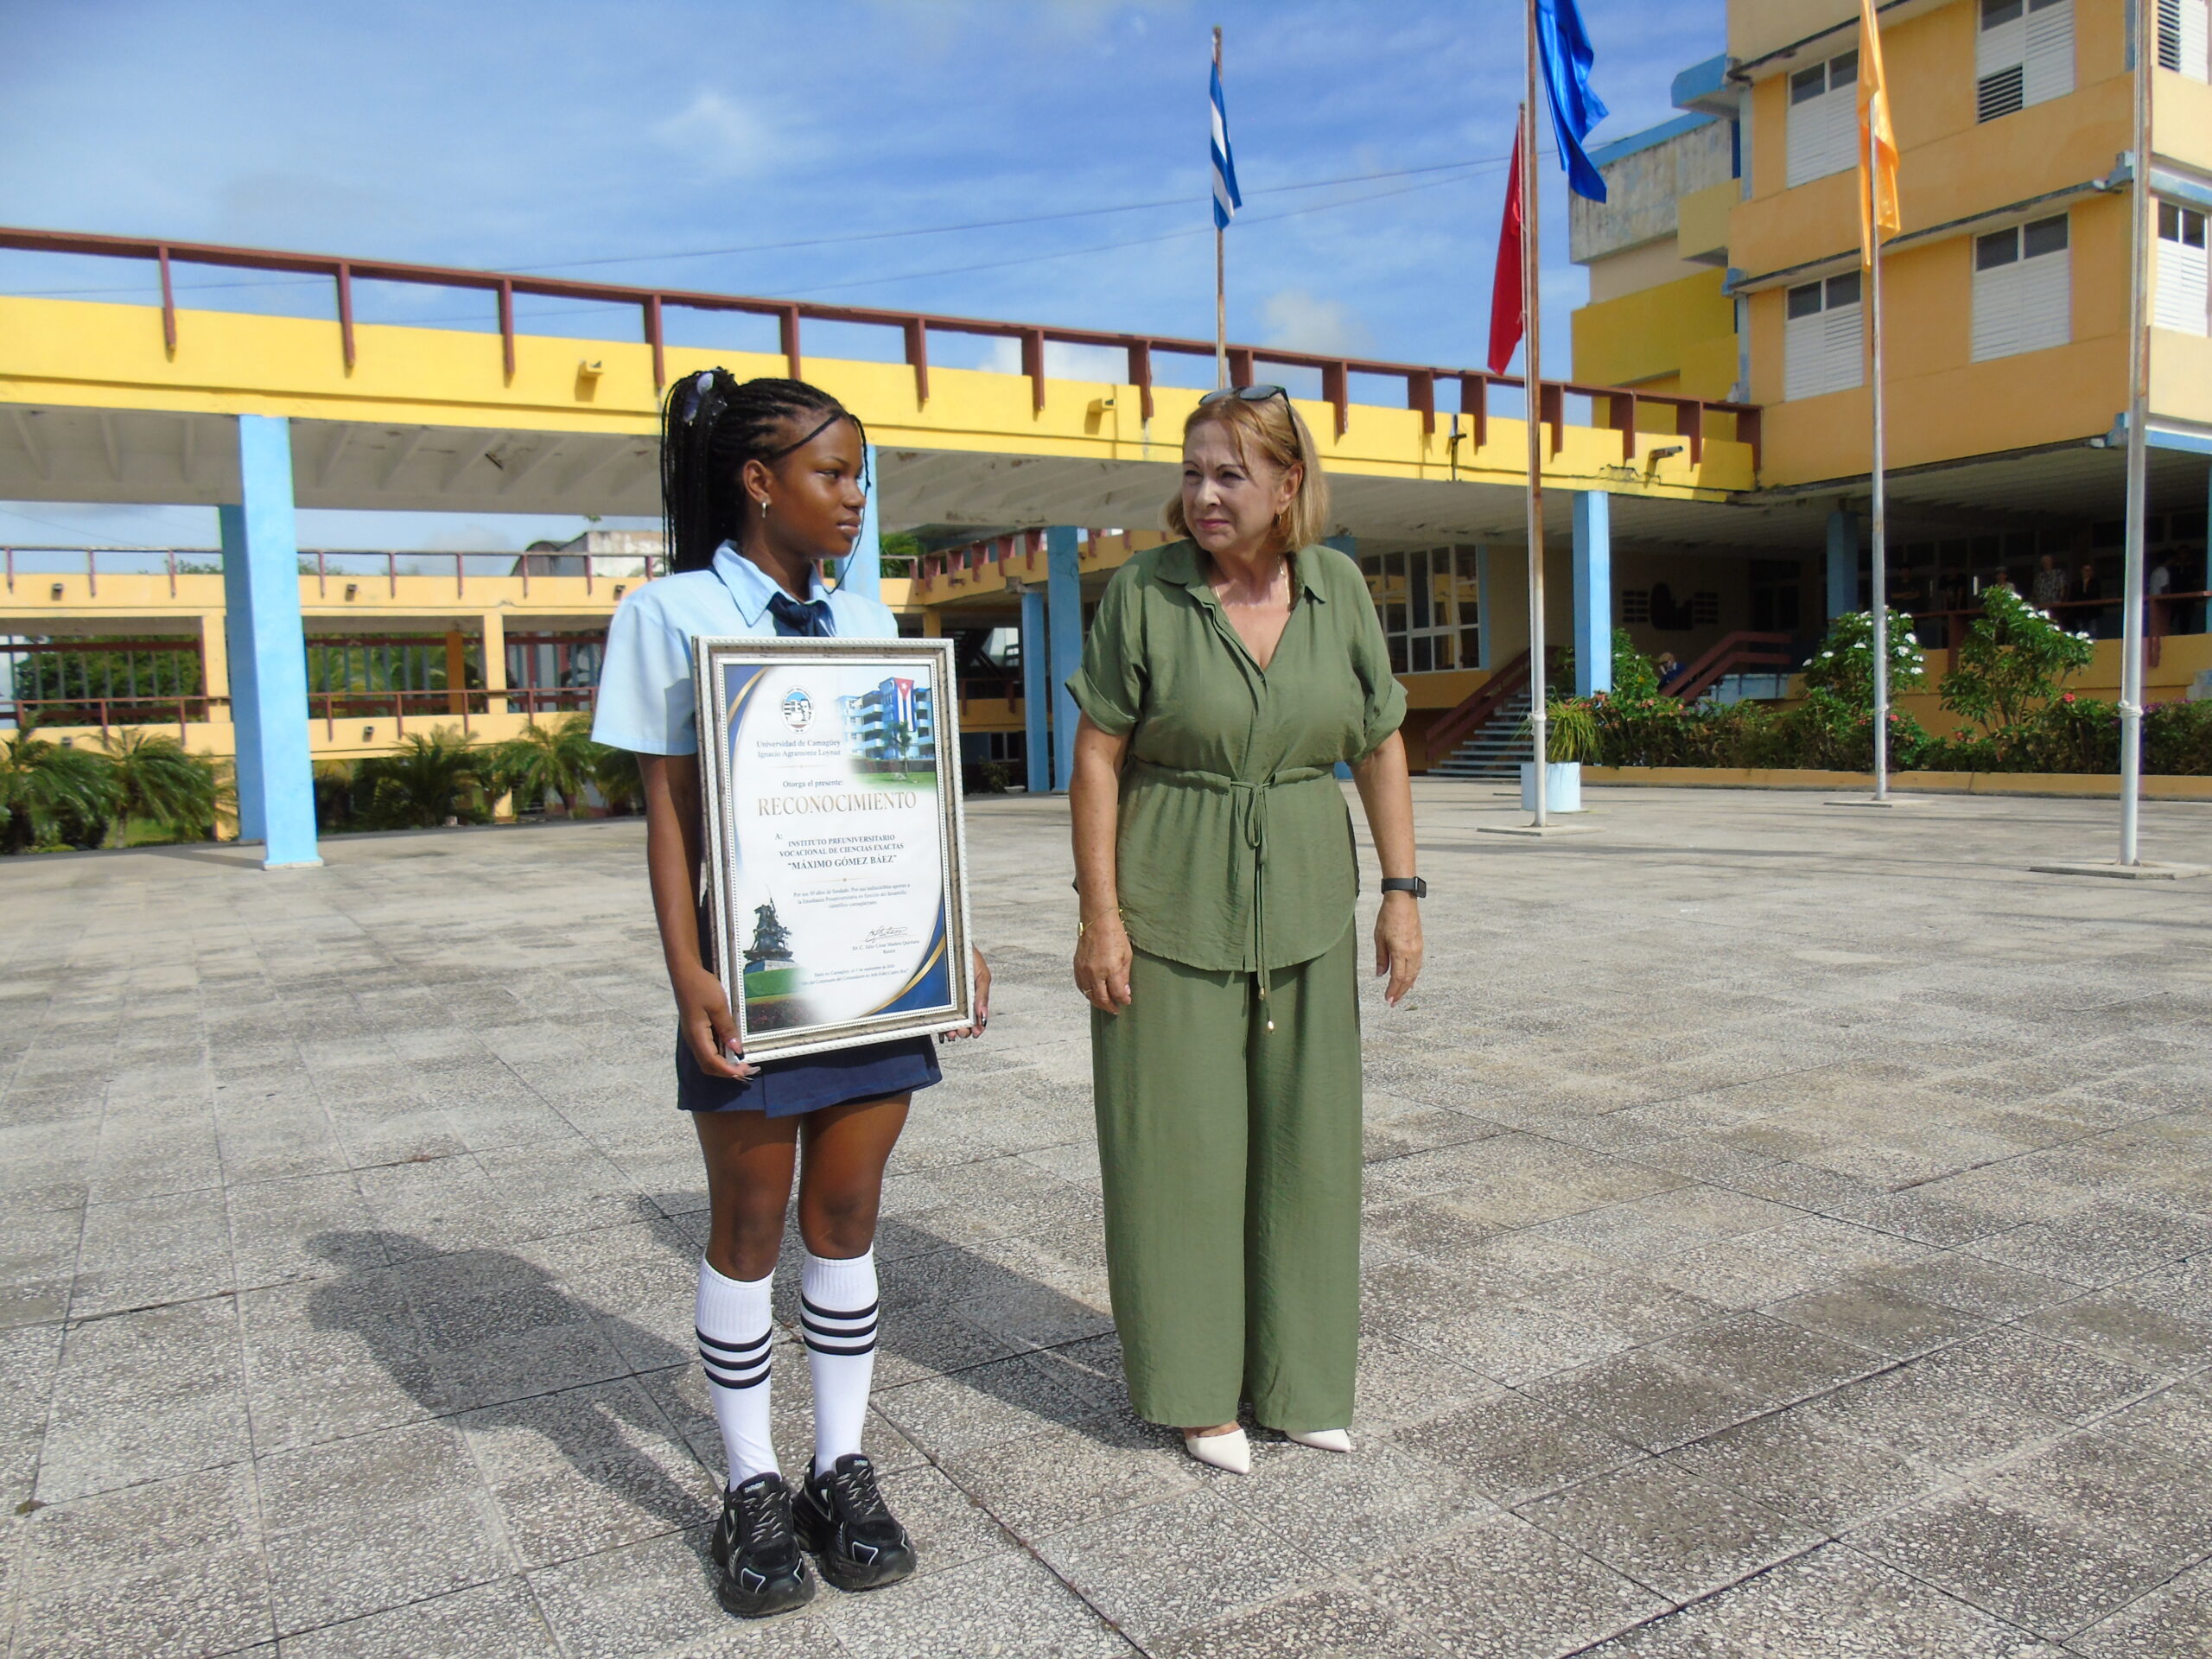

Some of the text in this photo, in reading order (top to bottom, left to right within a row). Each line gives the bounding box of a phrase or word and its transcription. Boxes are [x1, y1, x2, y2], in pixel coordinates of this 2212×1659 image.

[756, 739, 841, 748] Universidad de Camagüey
[757, 749, 841, 759] Ignacio Agramonte Loynaz
[782, 780, 806, 789] Otorga
[815, 779, 844, 788] presente:
[758, 791, 917, 817] RECONOCIMIENTO
[788, 834, 895, 847] INSTITUTO PREUNIVERSITARIO
[779, 847, 827, 857] VOCACIONAL
[839, 845, 873, 853] CIENCIAS
[874, 843, 904, 852] EXACTAS
[834, 855, 868, 867] GÓMEZ
